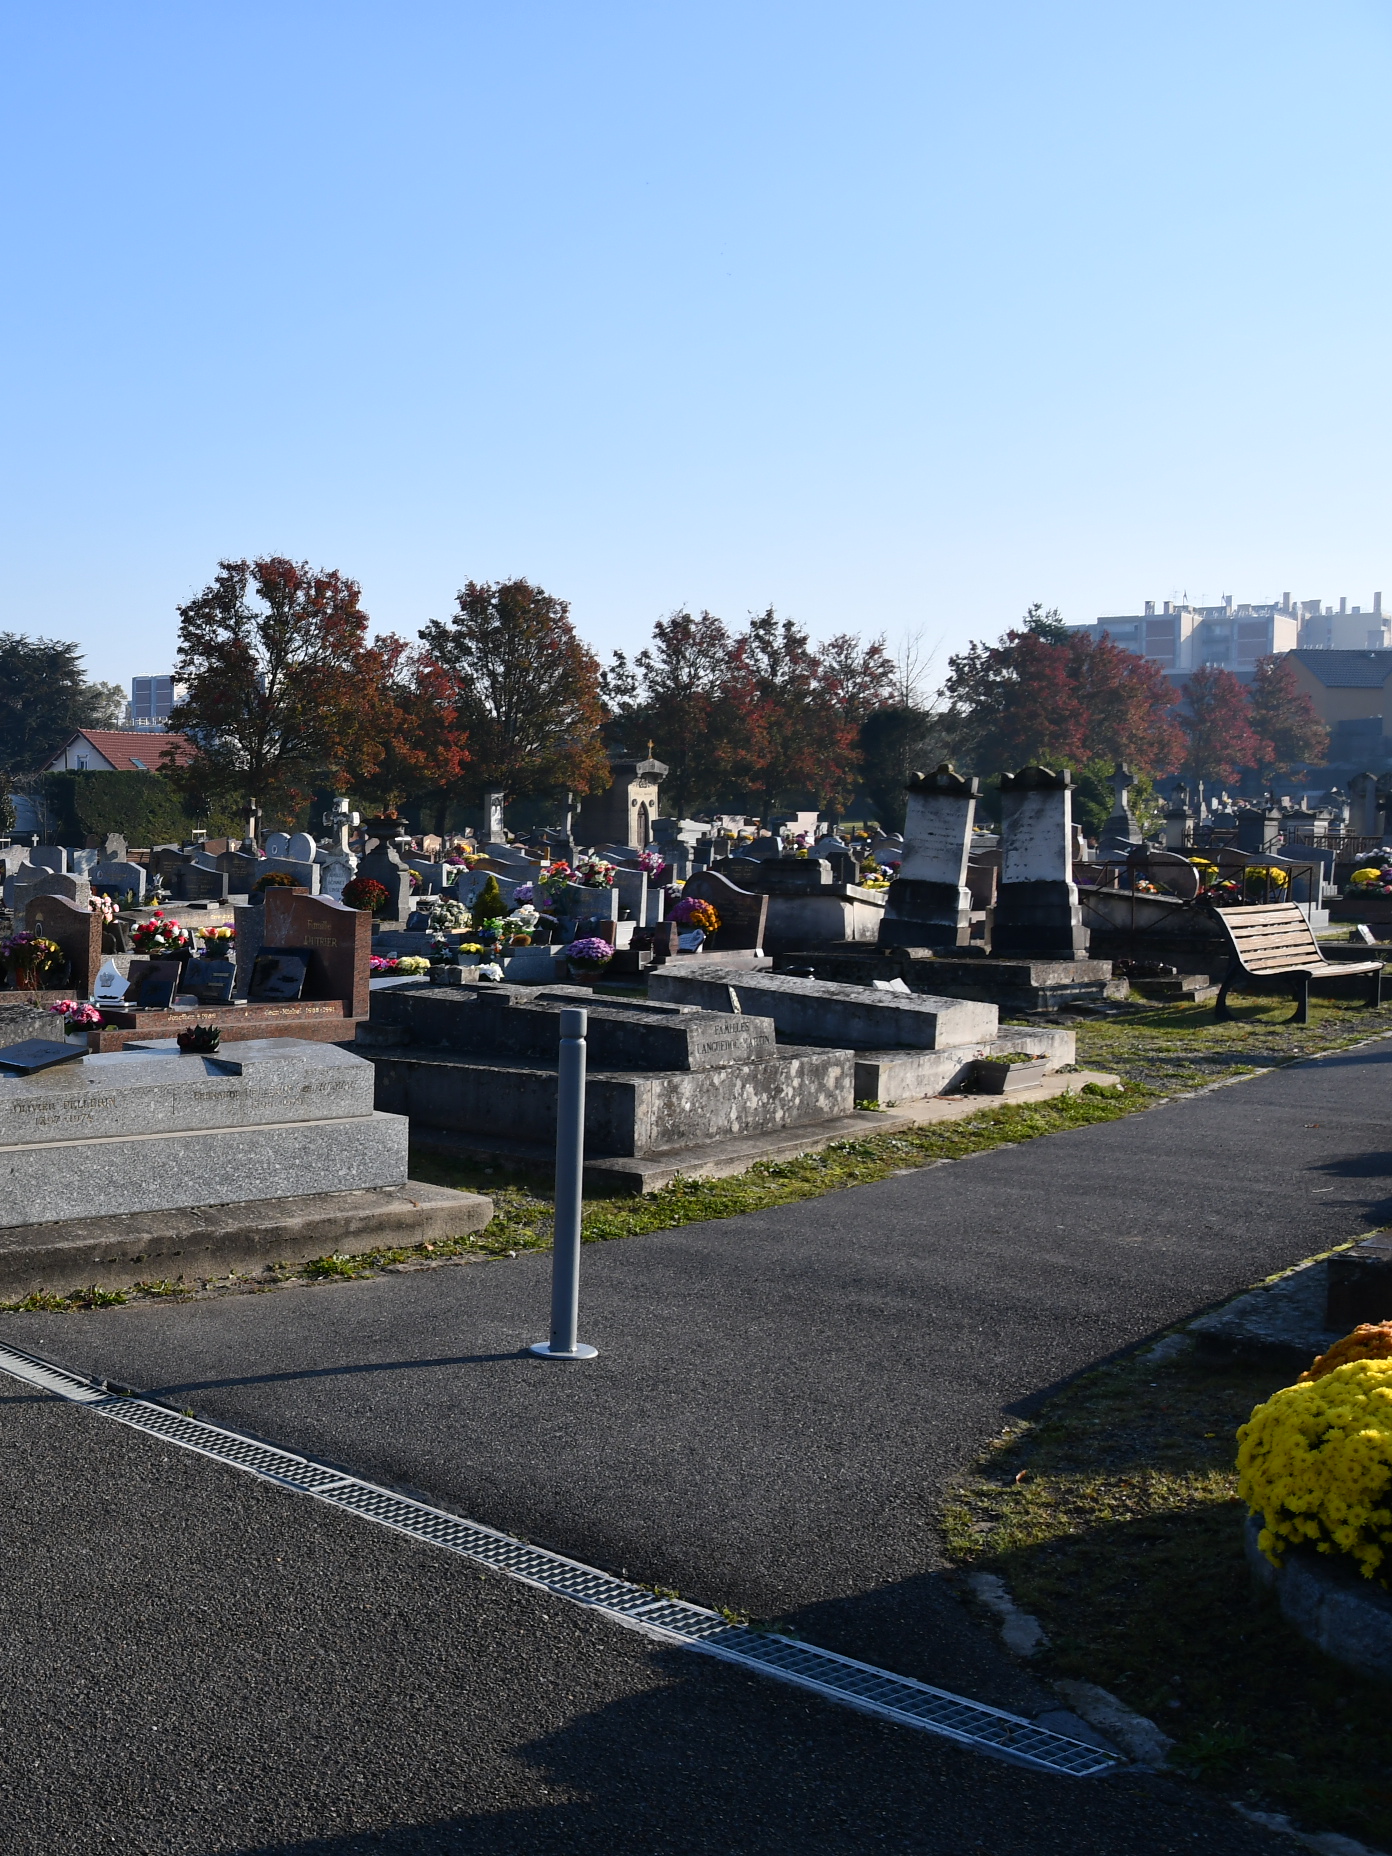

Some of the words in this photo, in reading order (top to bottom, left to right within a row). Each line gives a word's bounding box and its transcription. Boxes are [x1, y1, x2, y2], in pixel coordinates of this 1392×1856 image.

[306, 919, 332, 931] Famille
[714, 1021, 750, 1035] FAMILLES
[12, 1102, 56, 1114] OLIVIER
[63, 1096, 118, 1110] PELLERIN
